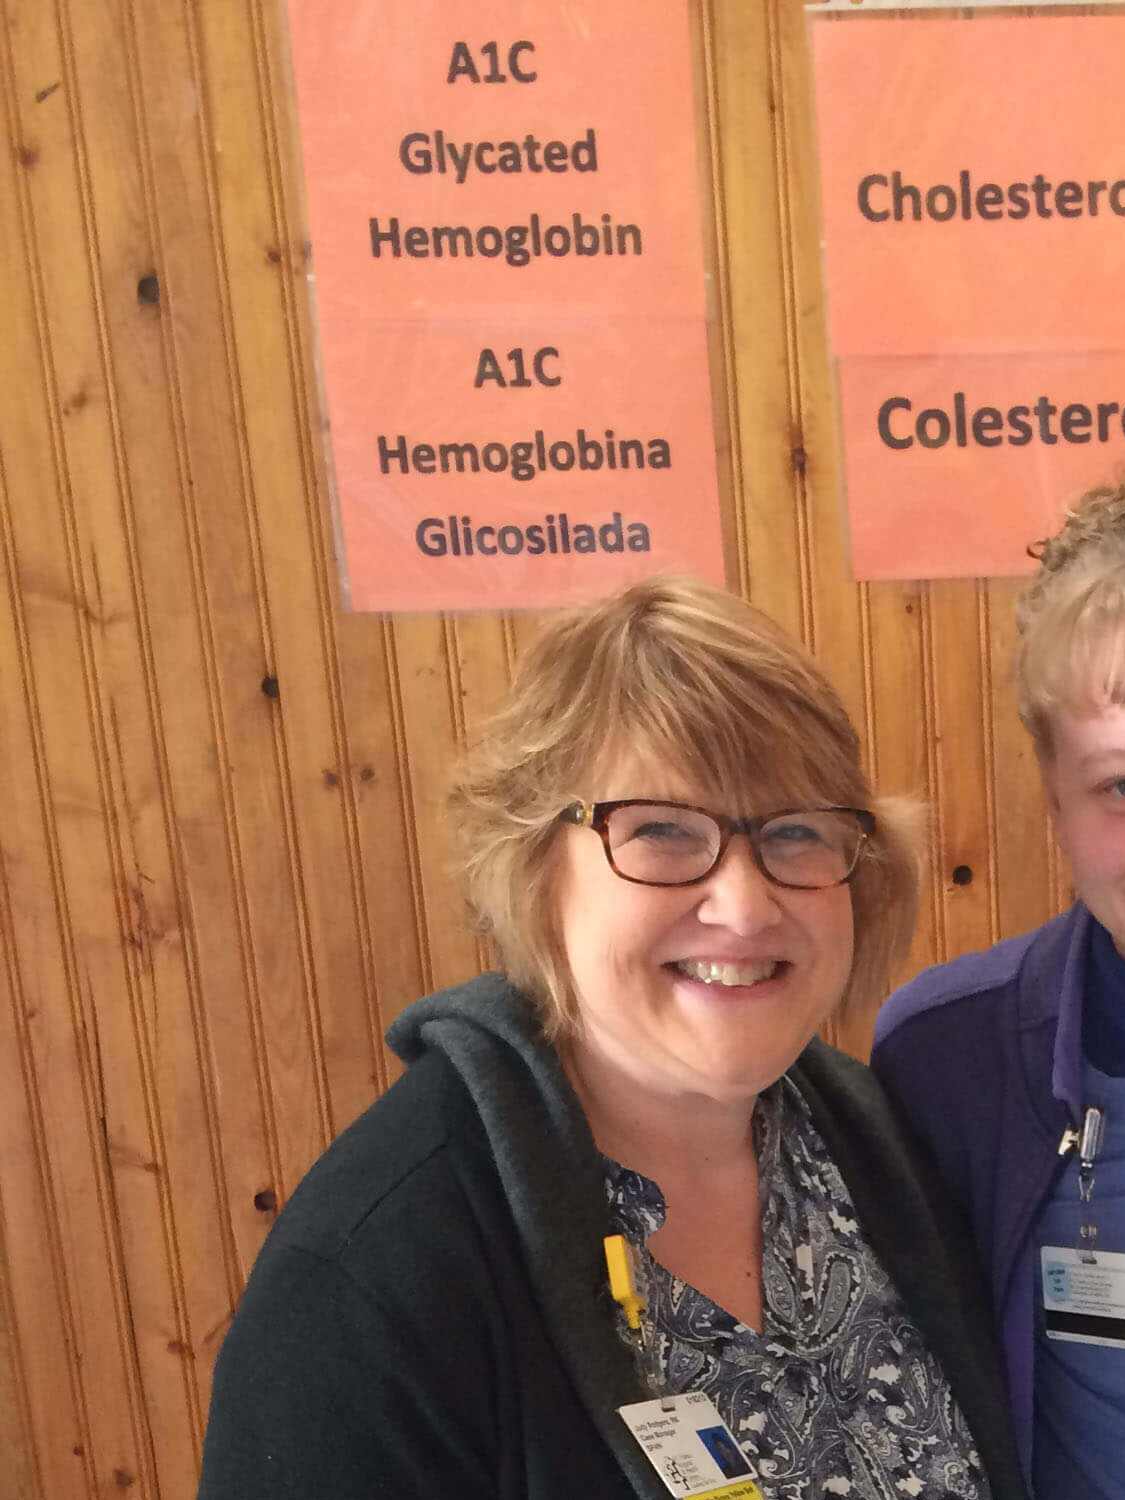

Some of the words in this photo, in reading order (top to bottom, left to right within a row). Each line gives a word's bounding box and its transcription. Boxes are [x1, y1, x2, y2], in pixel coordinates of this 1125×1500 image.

[447, 40, 537, 84] A1C
[400, 128, 598, 184] Glycated
[369, 213, 643, 267] Hemoglobin
[474, 347, 562, 388] A1C
[377, 429, 672, 481] Hemoglobina
[415, 511, 651, 557] Glicosilada
